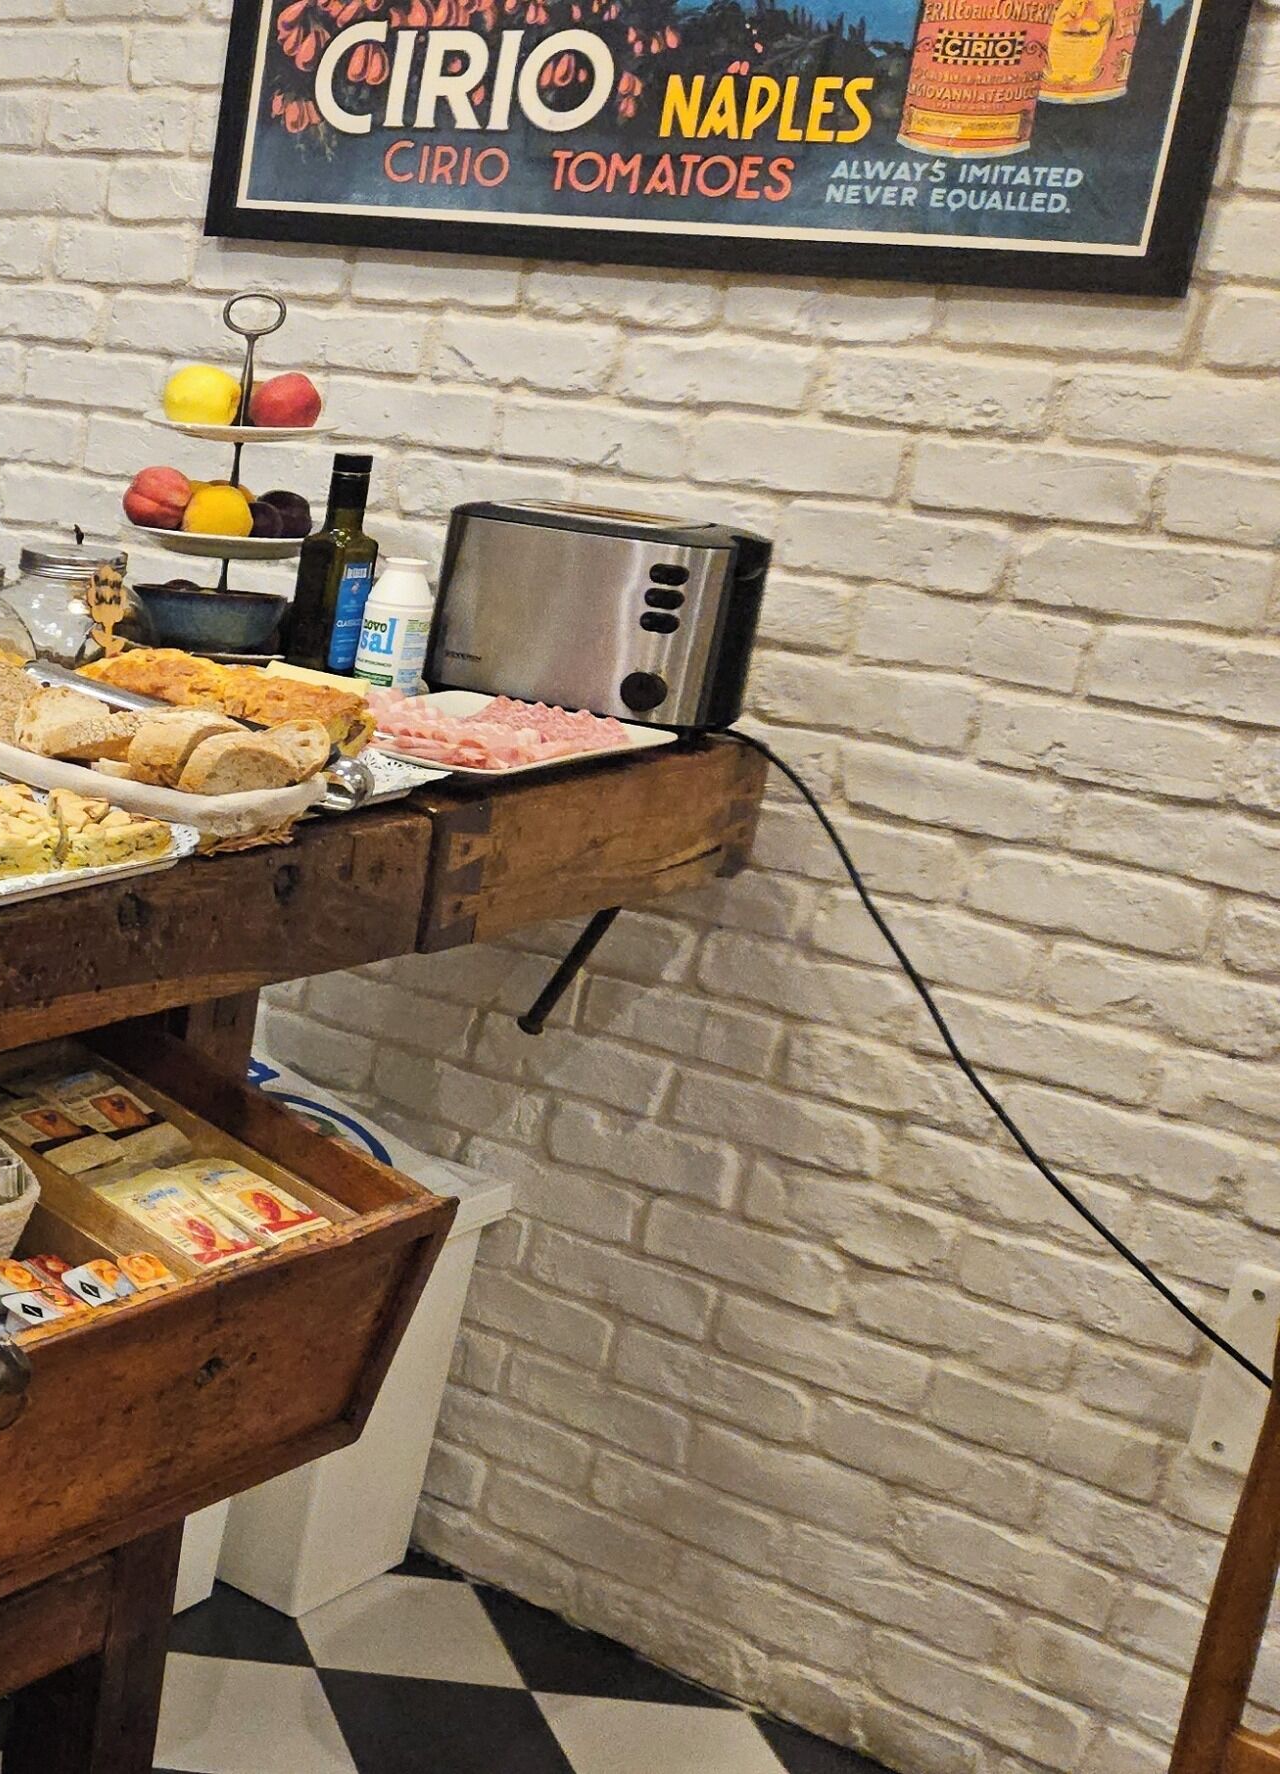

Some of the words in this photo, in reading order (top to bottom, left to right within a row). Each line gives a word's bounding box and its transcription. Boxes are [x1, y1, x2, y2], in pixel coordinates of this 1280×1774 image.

[943, 38, 1013, 59] CIRIO
[314, 20, 615, 134] CIRIO
[658, 74, 874, 143] NAPLES
[383, 140, 511, 188] CIRIO
[552, 150, 796, 202] TOMATOES
[830, 159, 947, 183] ALWAYS
[958, 163, 1085, 188] IMITATED
[824, 183, 919, 208] NEVER
[929, 188, 1072, 214] EQUALLED.
